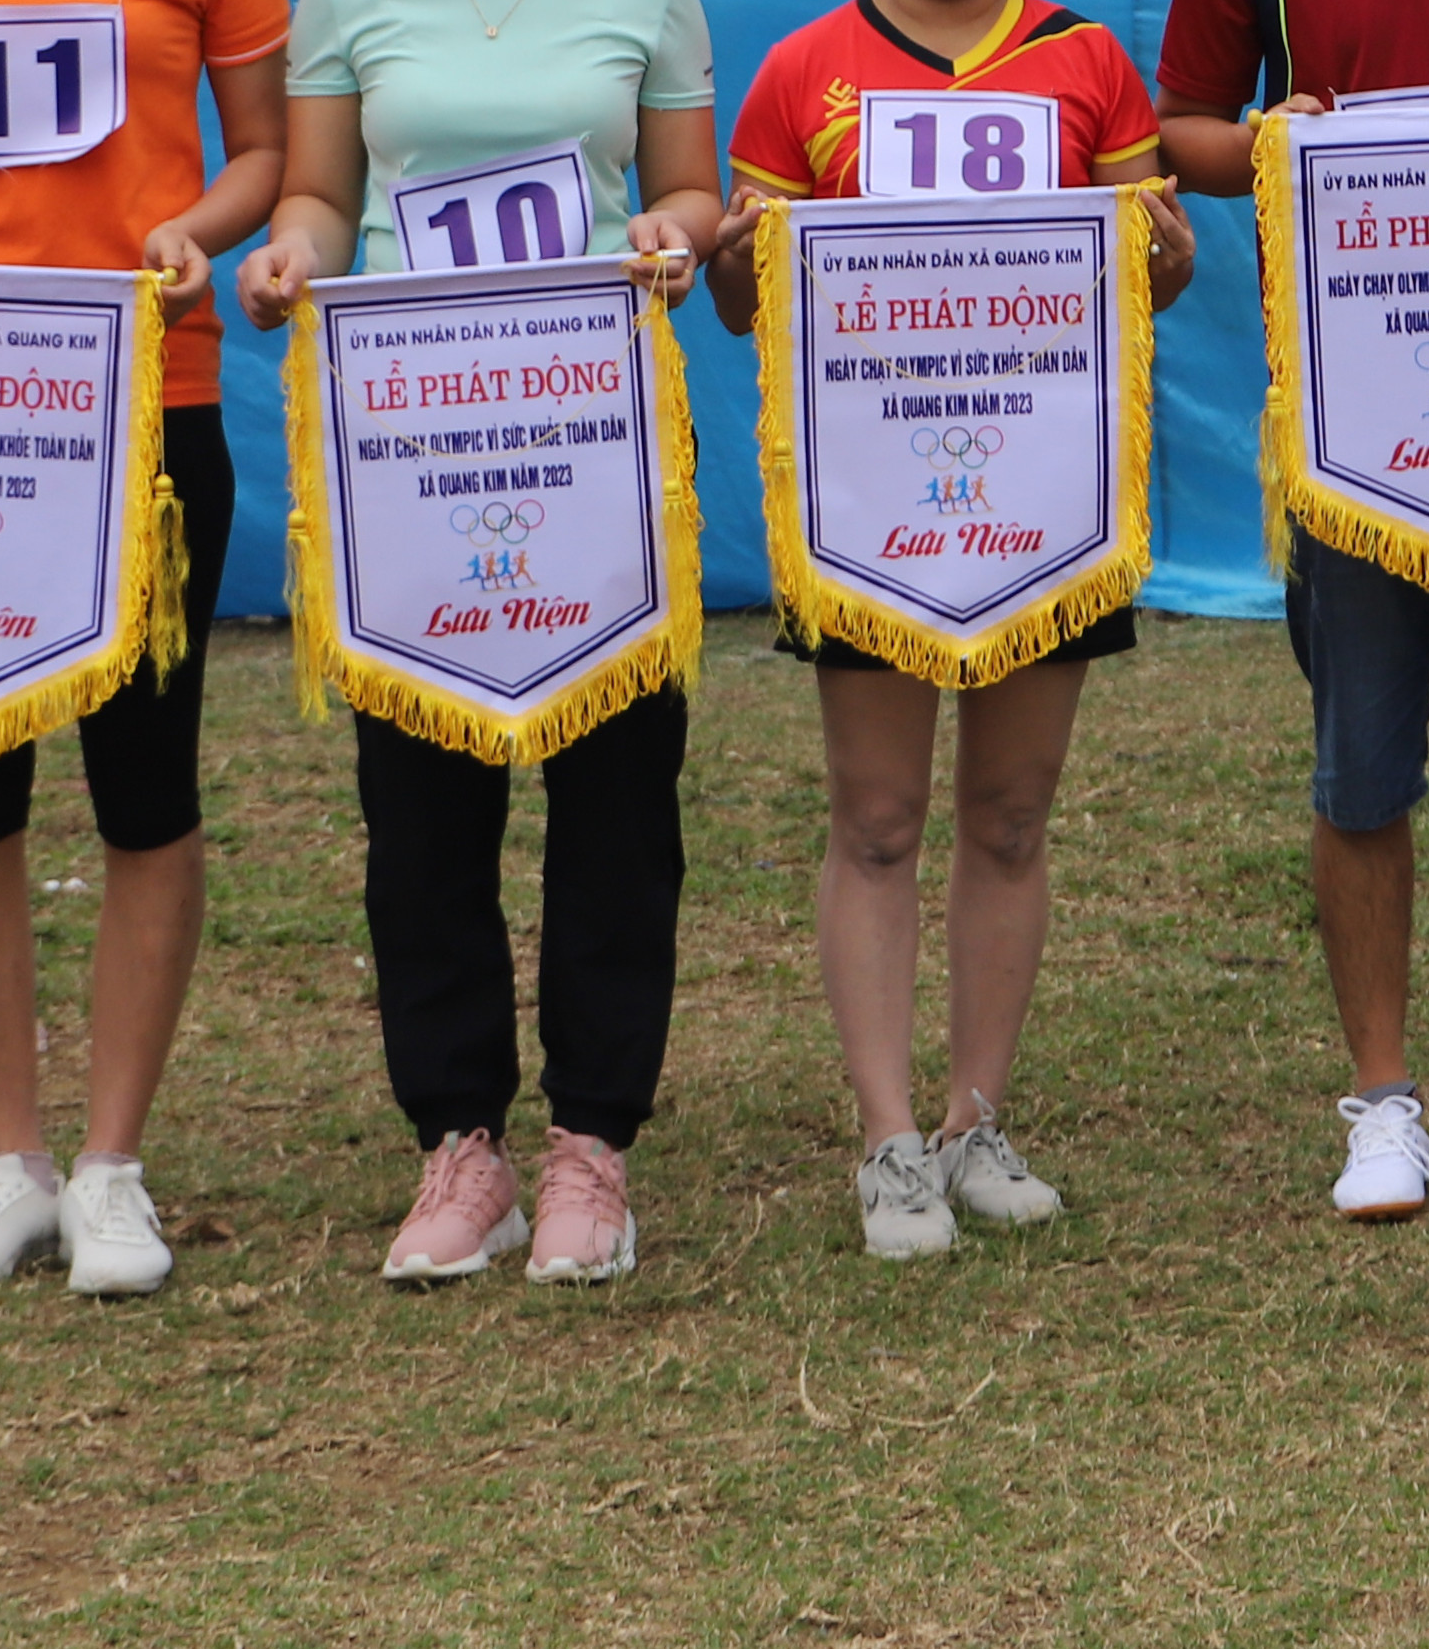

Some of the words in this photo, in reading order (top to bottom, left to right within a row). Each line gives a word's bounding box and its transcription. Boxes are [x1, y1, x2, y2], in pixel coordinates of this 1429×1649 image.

[895, 113, 1024, 192] 18
[1348, 174, 1377, 189] BAN
[1383, 168, 1425, 187] NHÂN
[427, 182, 564, 265] 10
[1336, 201, 1377, 249] LỄ
[835, 283, 876, 333] LỄ
[887, 288, 976, 330] PHÁT
[988, 285, 1084, 334] ĐỘNG
[1328, 272, 1359, 297] NGÀY
[1364, 274, 1393, 300] CHẠY
[1386, 308, 1401, 334] XÃ
[364, 360, 407, 411] LỄ
[418, 361, 510, 407] PHÁT
[521, 354, 621, 405] ĐỘNG
